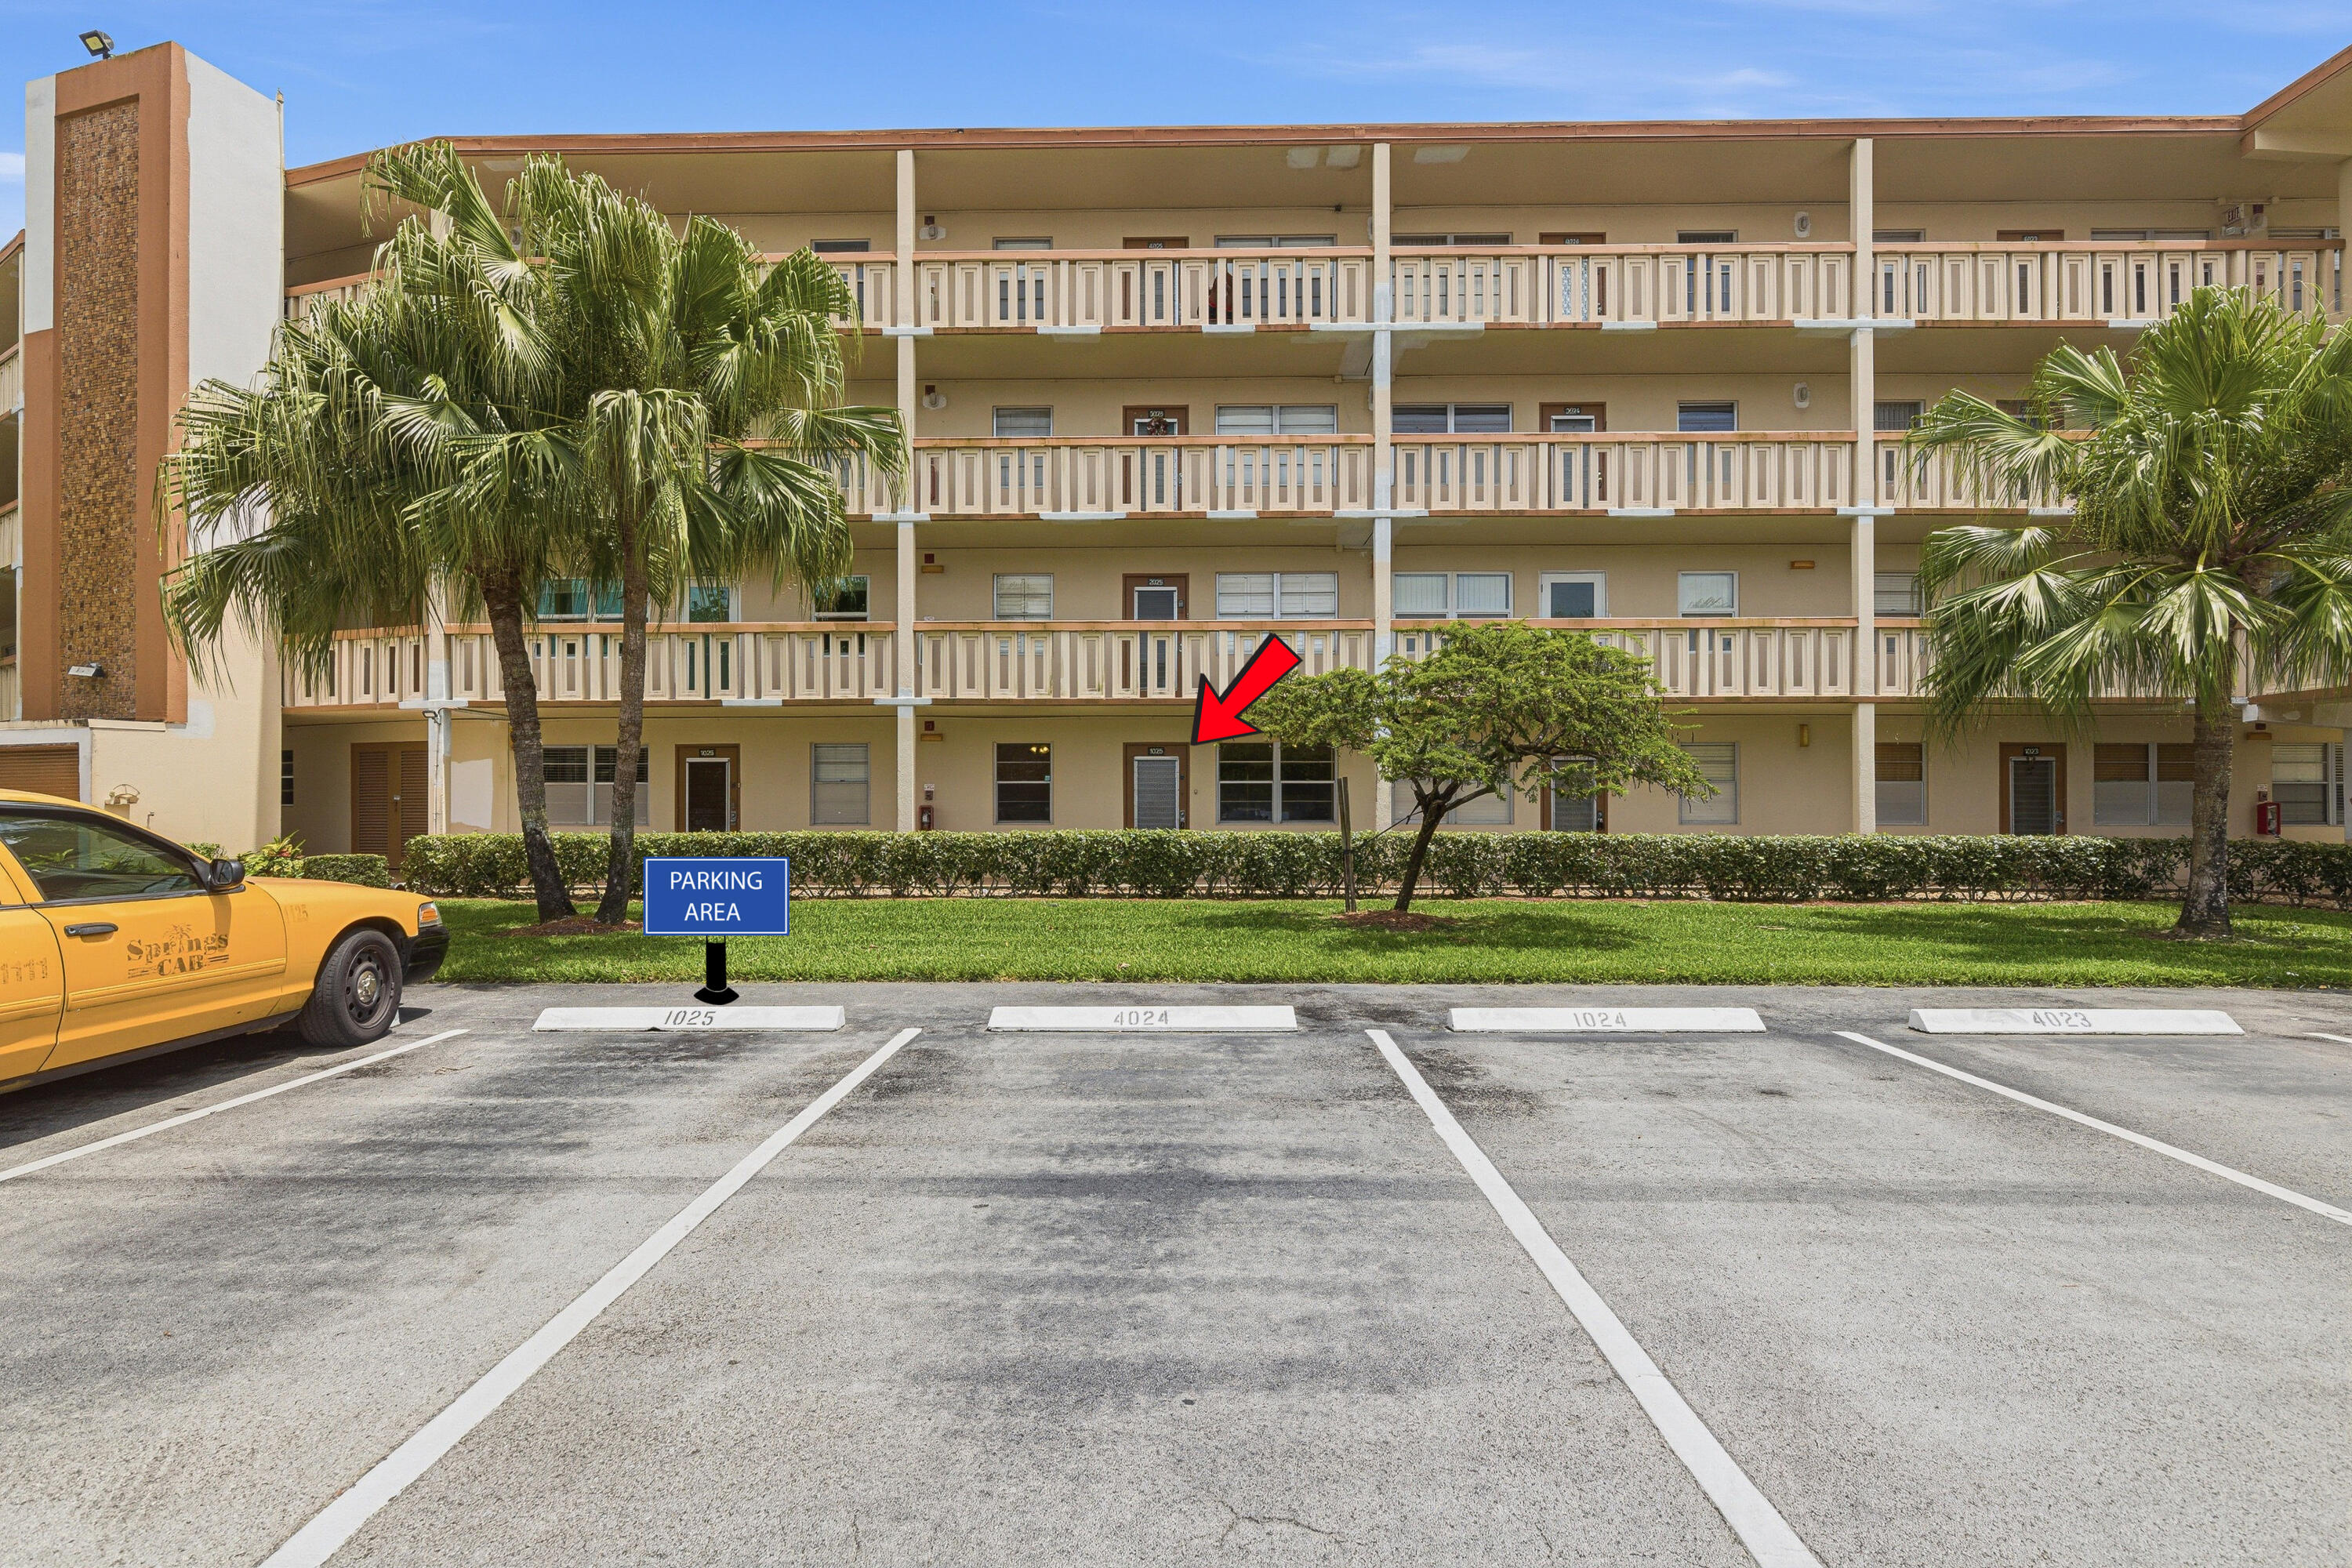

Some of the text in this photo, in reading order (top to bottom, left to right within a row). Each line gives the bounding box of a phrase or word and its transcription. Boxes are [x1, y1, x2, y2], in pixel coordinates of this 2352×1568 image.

[126, 933, 229, 965] Springs
[158, 954, 205, 976] CAB
[664, 1010, 717, 1026] 1025
[1113, 1009, 1168, 1025] 4024
[1573, 1011, 1627, 1028] 1024
[2032, 1011, 2092, 1028] 4023
